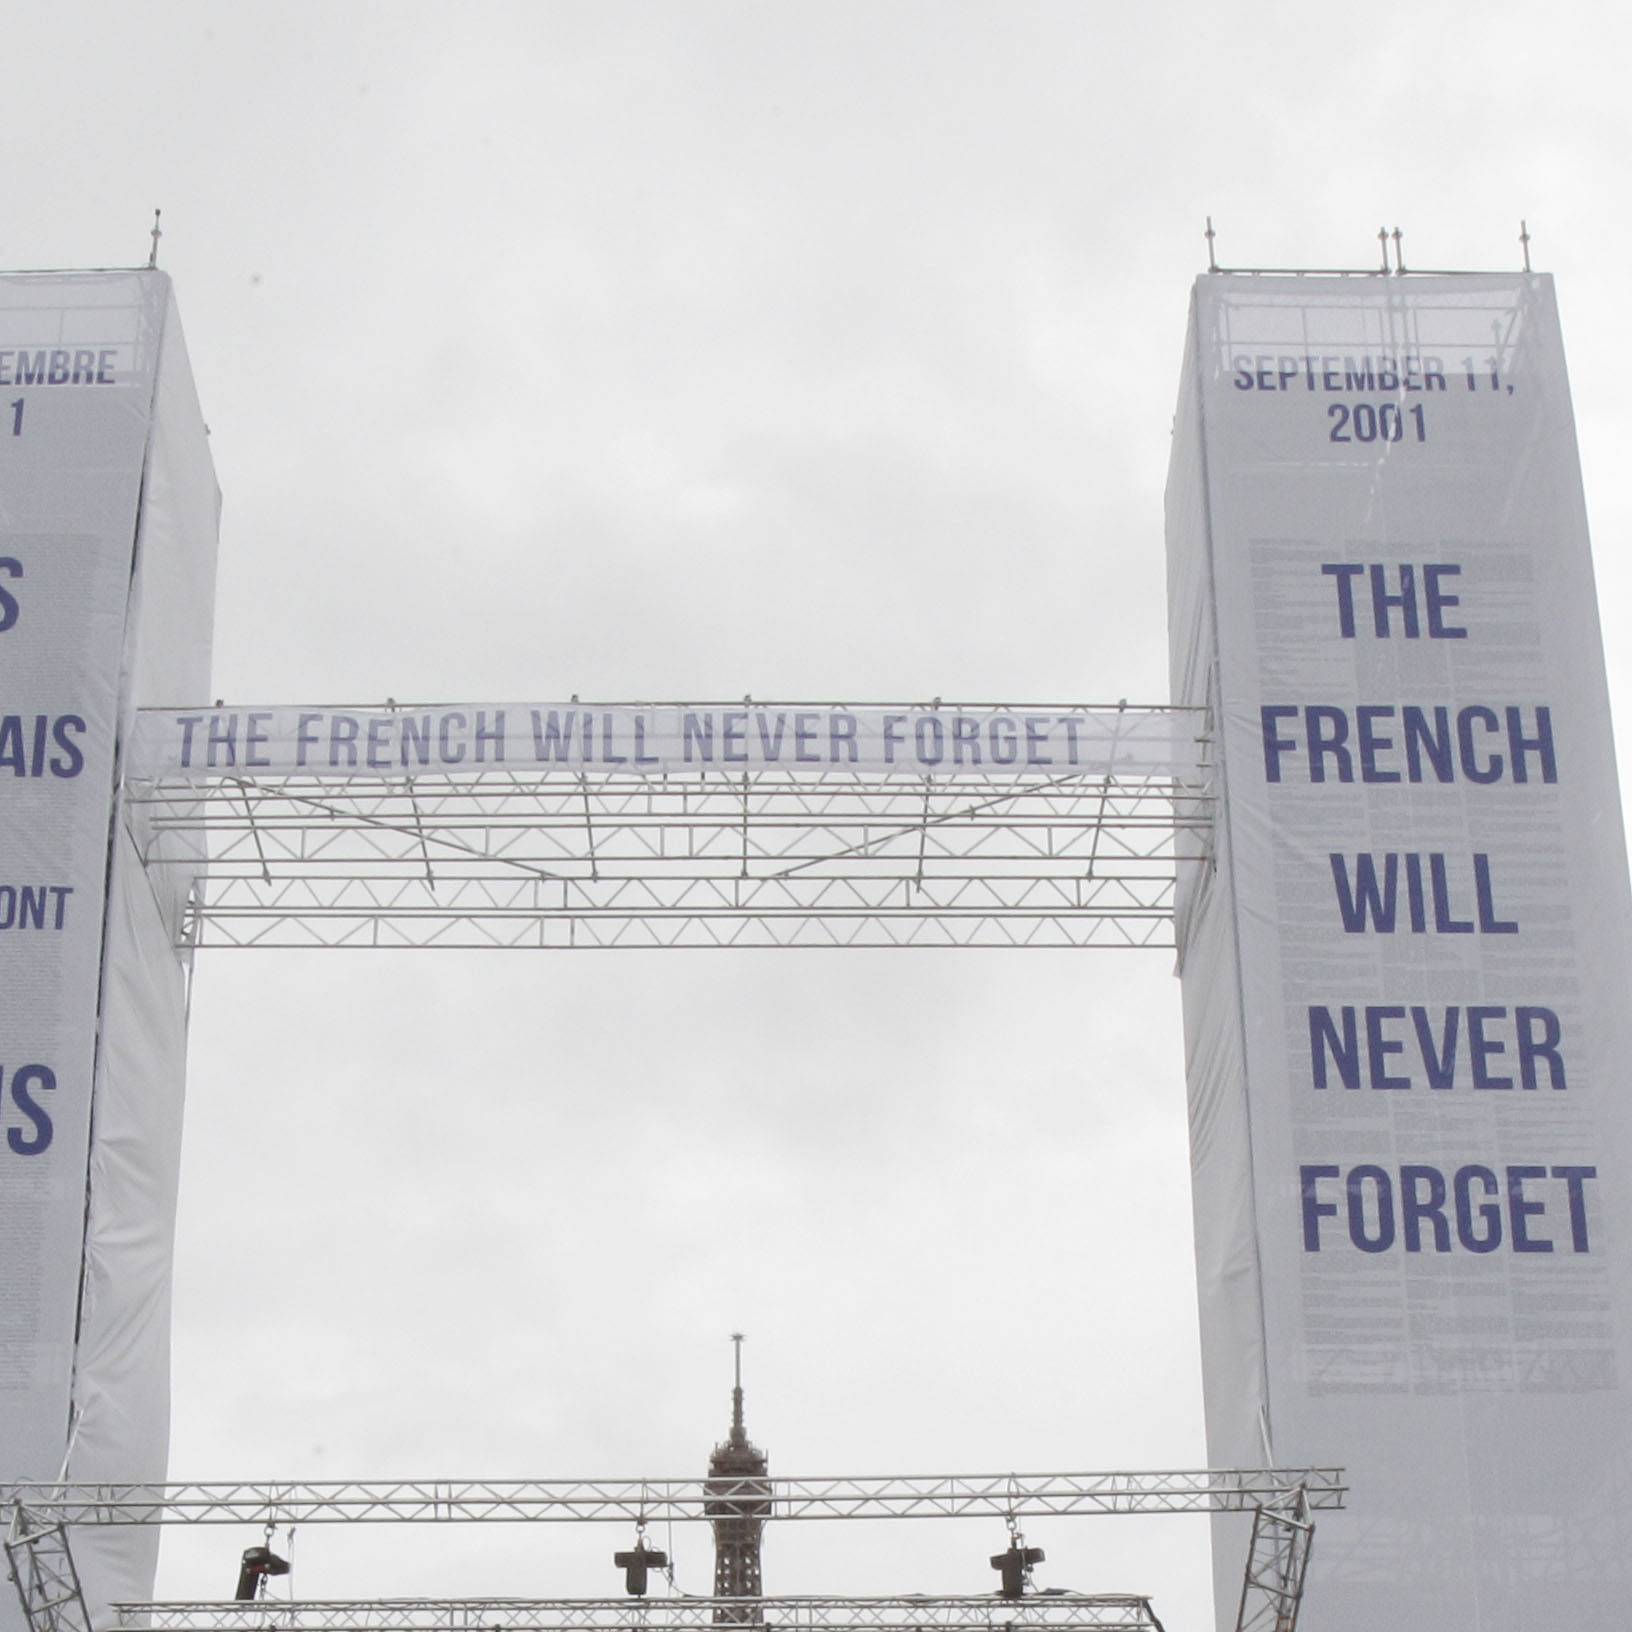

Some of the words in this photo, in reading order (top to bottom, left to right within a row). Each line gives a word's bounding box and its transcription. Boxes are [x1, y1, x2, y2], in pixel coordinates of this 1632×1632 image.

[1233, 354, 1446, 392] SEPTEMBER
[1460, 356, 1514, 395] 11,
[1327, 402, 1426, 443] 2001
[1321, 563, 1468, 639] THE
[176, 712, 273, 768] THE
[296, 709, 506, 768] FRENCH
[530, 709, 660, 764] WILL
[682, 712, 859, 764] NEVER
[882, 714, 1086, 767] FORGET
[1260, 705, 1559, 785] FRENCH
[1329, 853, 1519, 934] WILL
[1308, 1005, 1567, 1091] NEVER
[1299, 1164, 1597, 1254] FORGET
